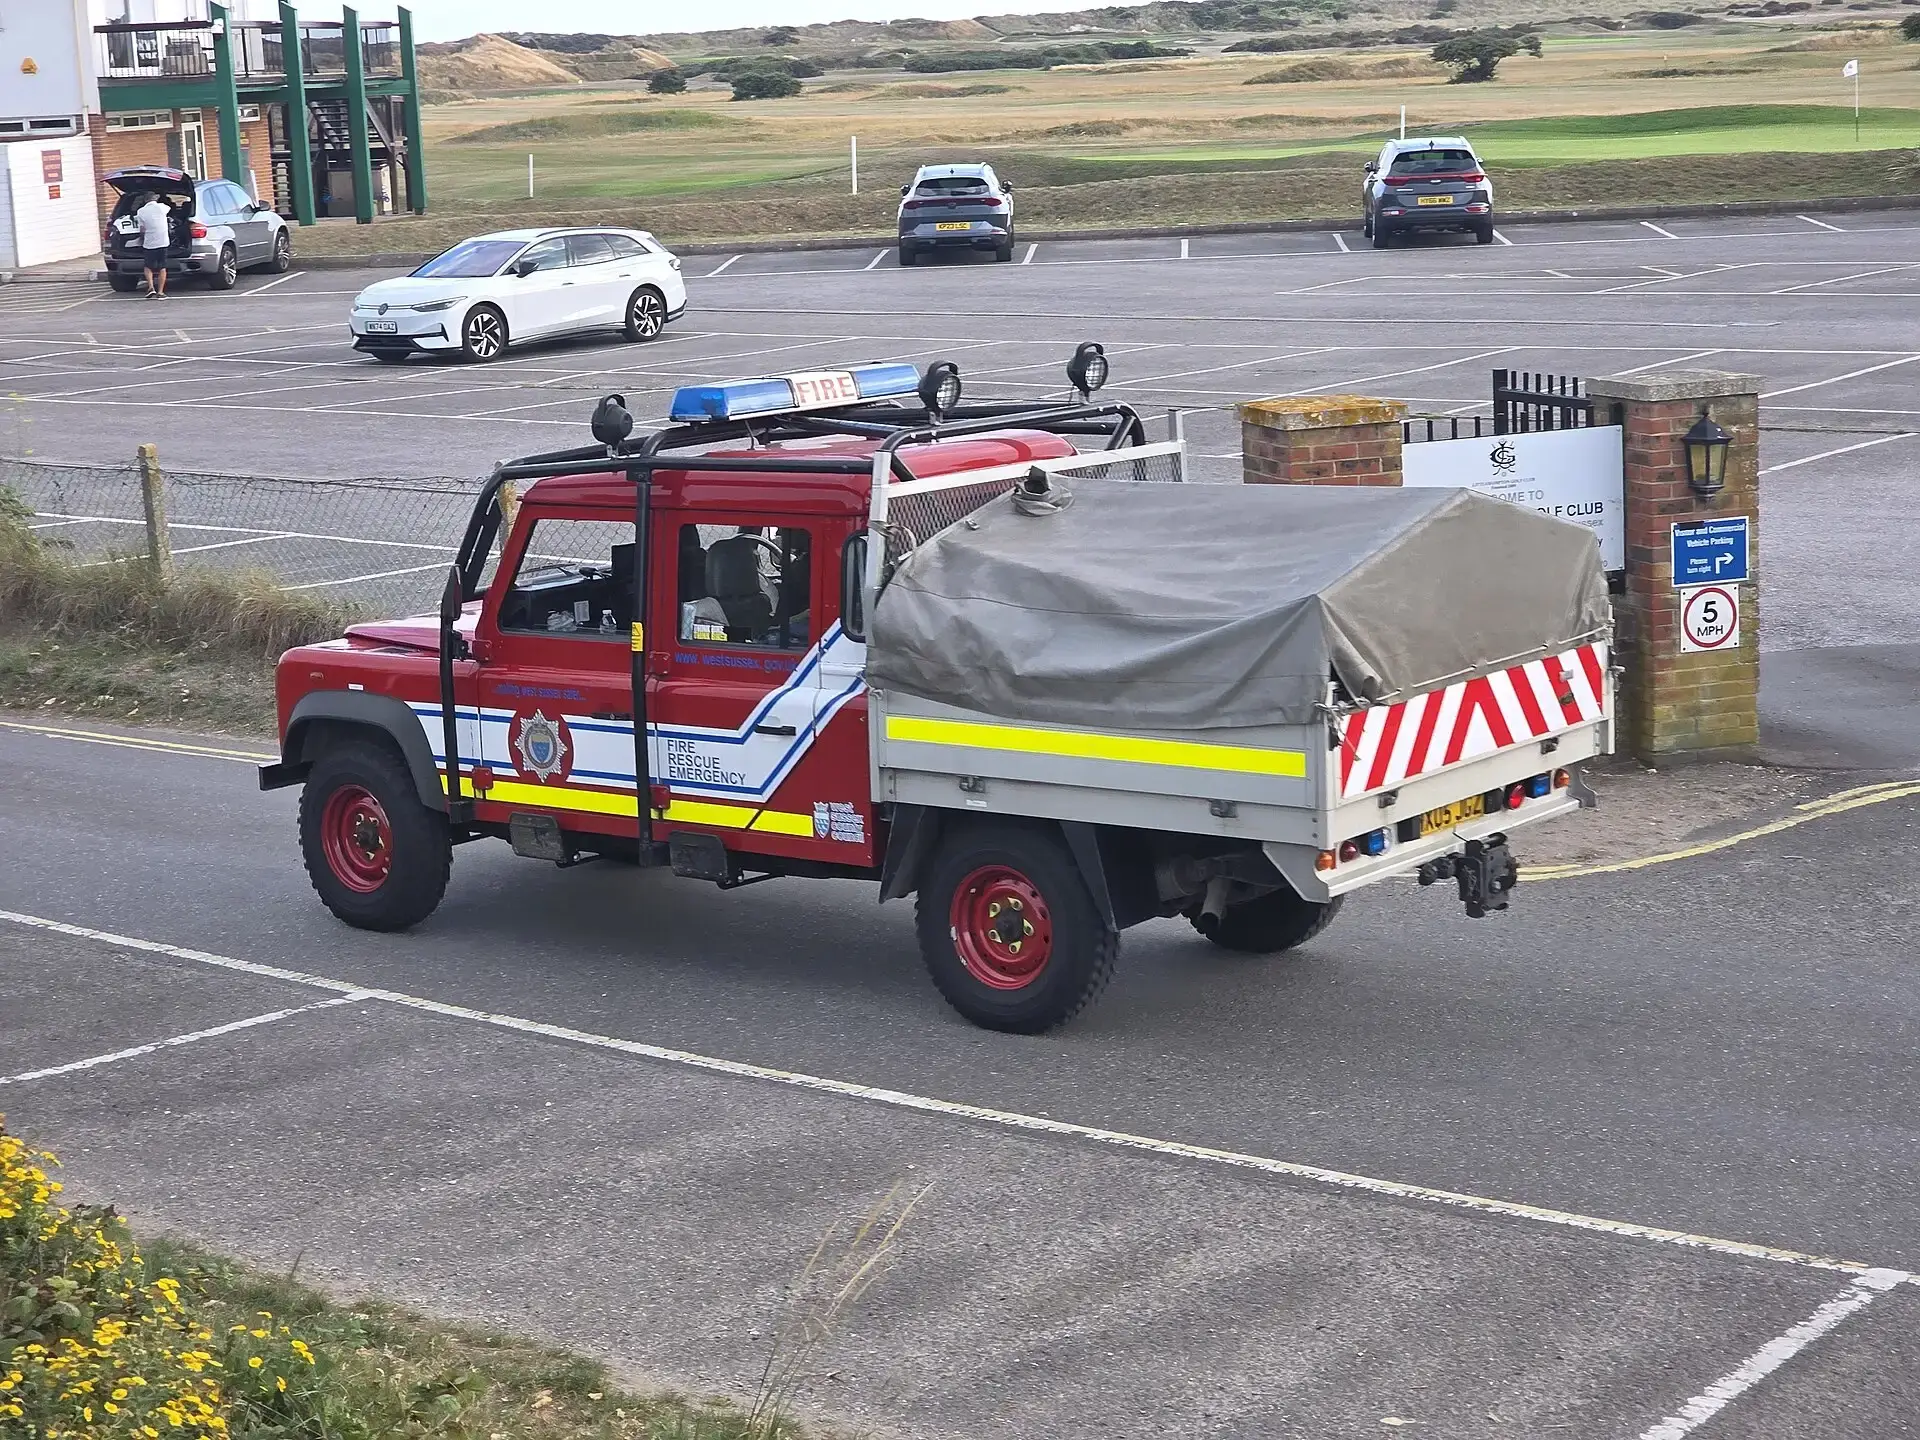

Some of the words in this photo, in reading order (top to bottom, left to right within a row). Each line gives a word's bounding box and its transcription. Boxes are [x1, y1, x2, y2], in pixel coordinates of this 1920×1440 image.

[795, 376, 855, 403] FIRE
[1528, 489, 1545, 500] TO
[1566, 501, 1604, 516] CLUB
[1696, 526, 1708, 535] and
[1709, 523, 1745, 534] Commercial
[1686, 538, 1709, 548] Vehicle
[1710, 537, 1734, 545] Parking
[1702, 600, 1718, 624] 5
[1696, 624, 1724, 637] MPH
[667, 739, 695, 754] FIRE
[668, 752, 720, 769] RESCUE
[669, 765, 746, 786] EMERGENCY
